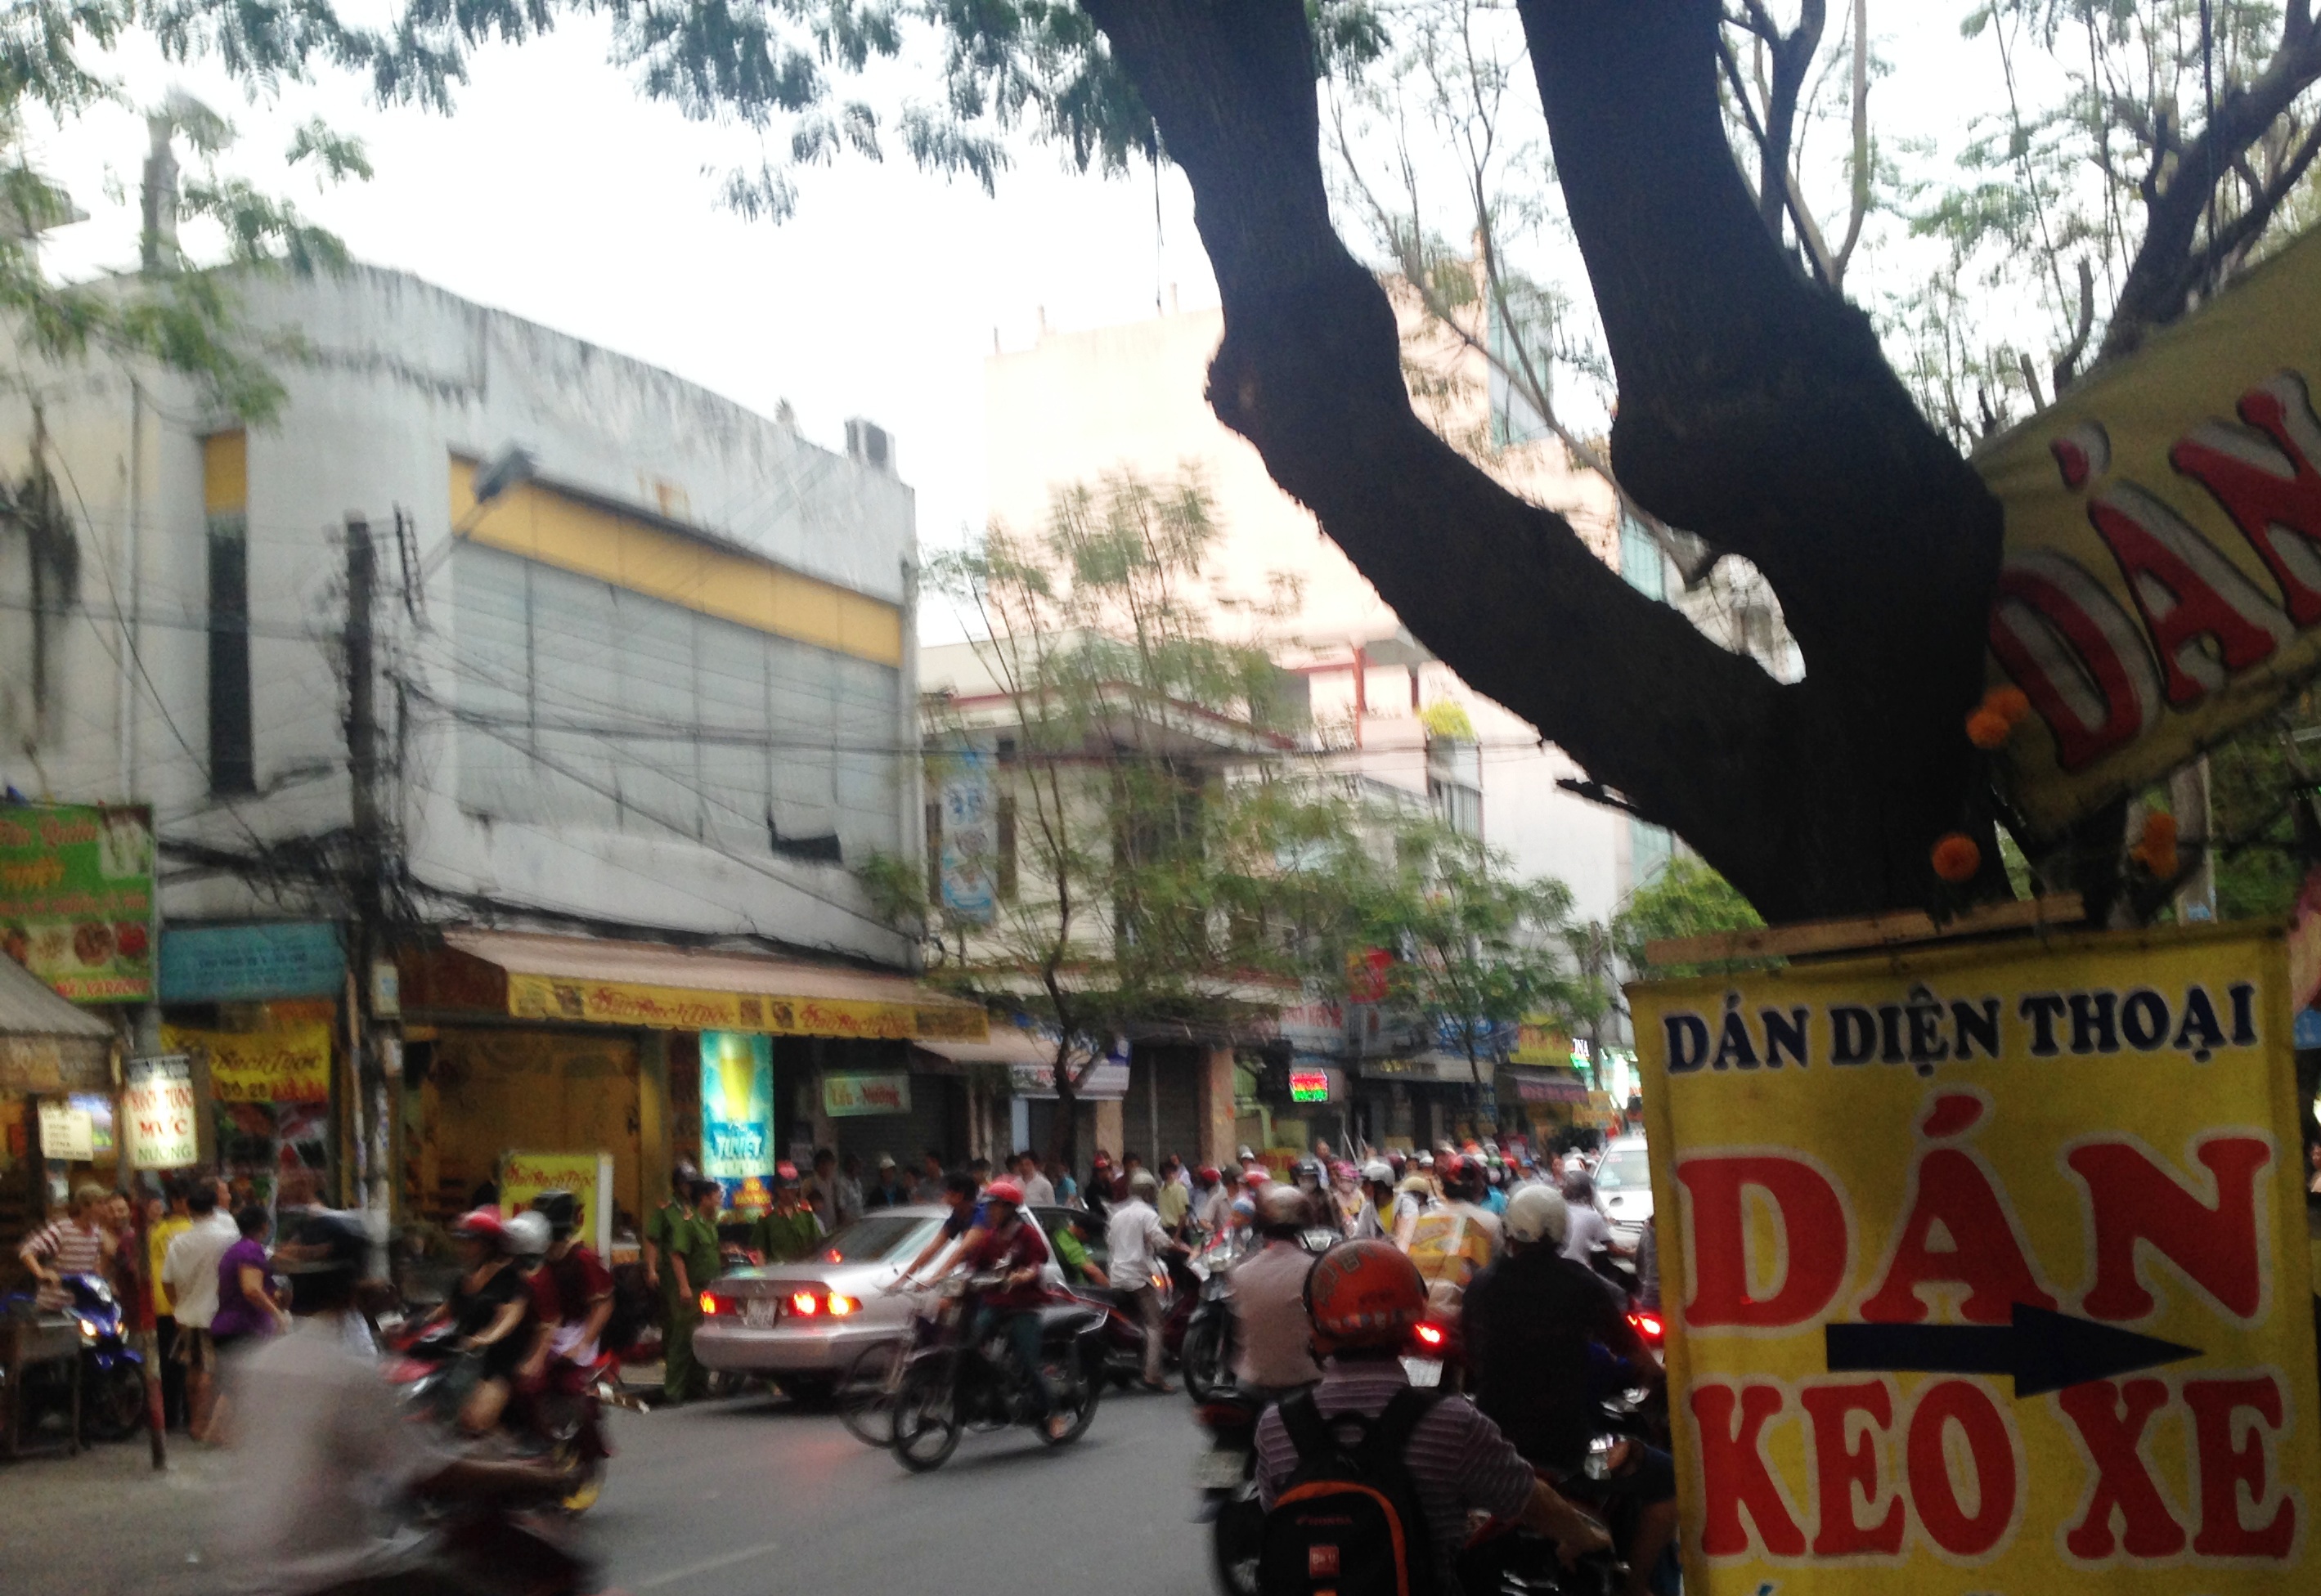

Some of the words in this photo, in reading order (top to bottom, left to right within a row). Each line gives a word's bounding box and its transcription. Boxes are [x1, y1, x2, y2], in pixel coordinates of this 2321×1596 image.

[1663, 993, 1809, 1074] DÁN
[2019, 985, 2257, 1063] THOẠI
[1677, 1095, 2270, 1328] DÁN
[1690, 1379, 2016, 1558] KEO
[2058, 1379, 2296, 1559] XE
